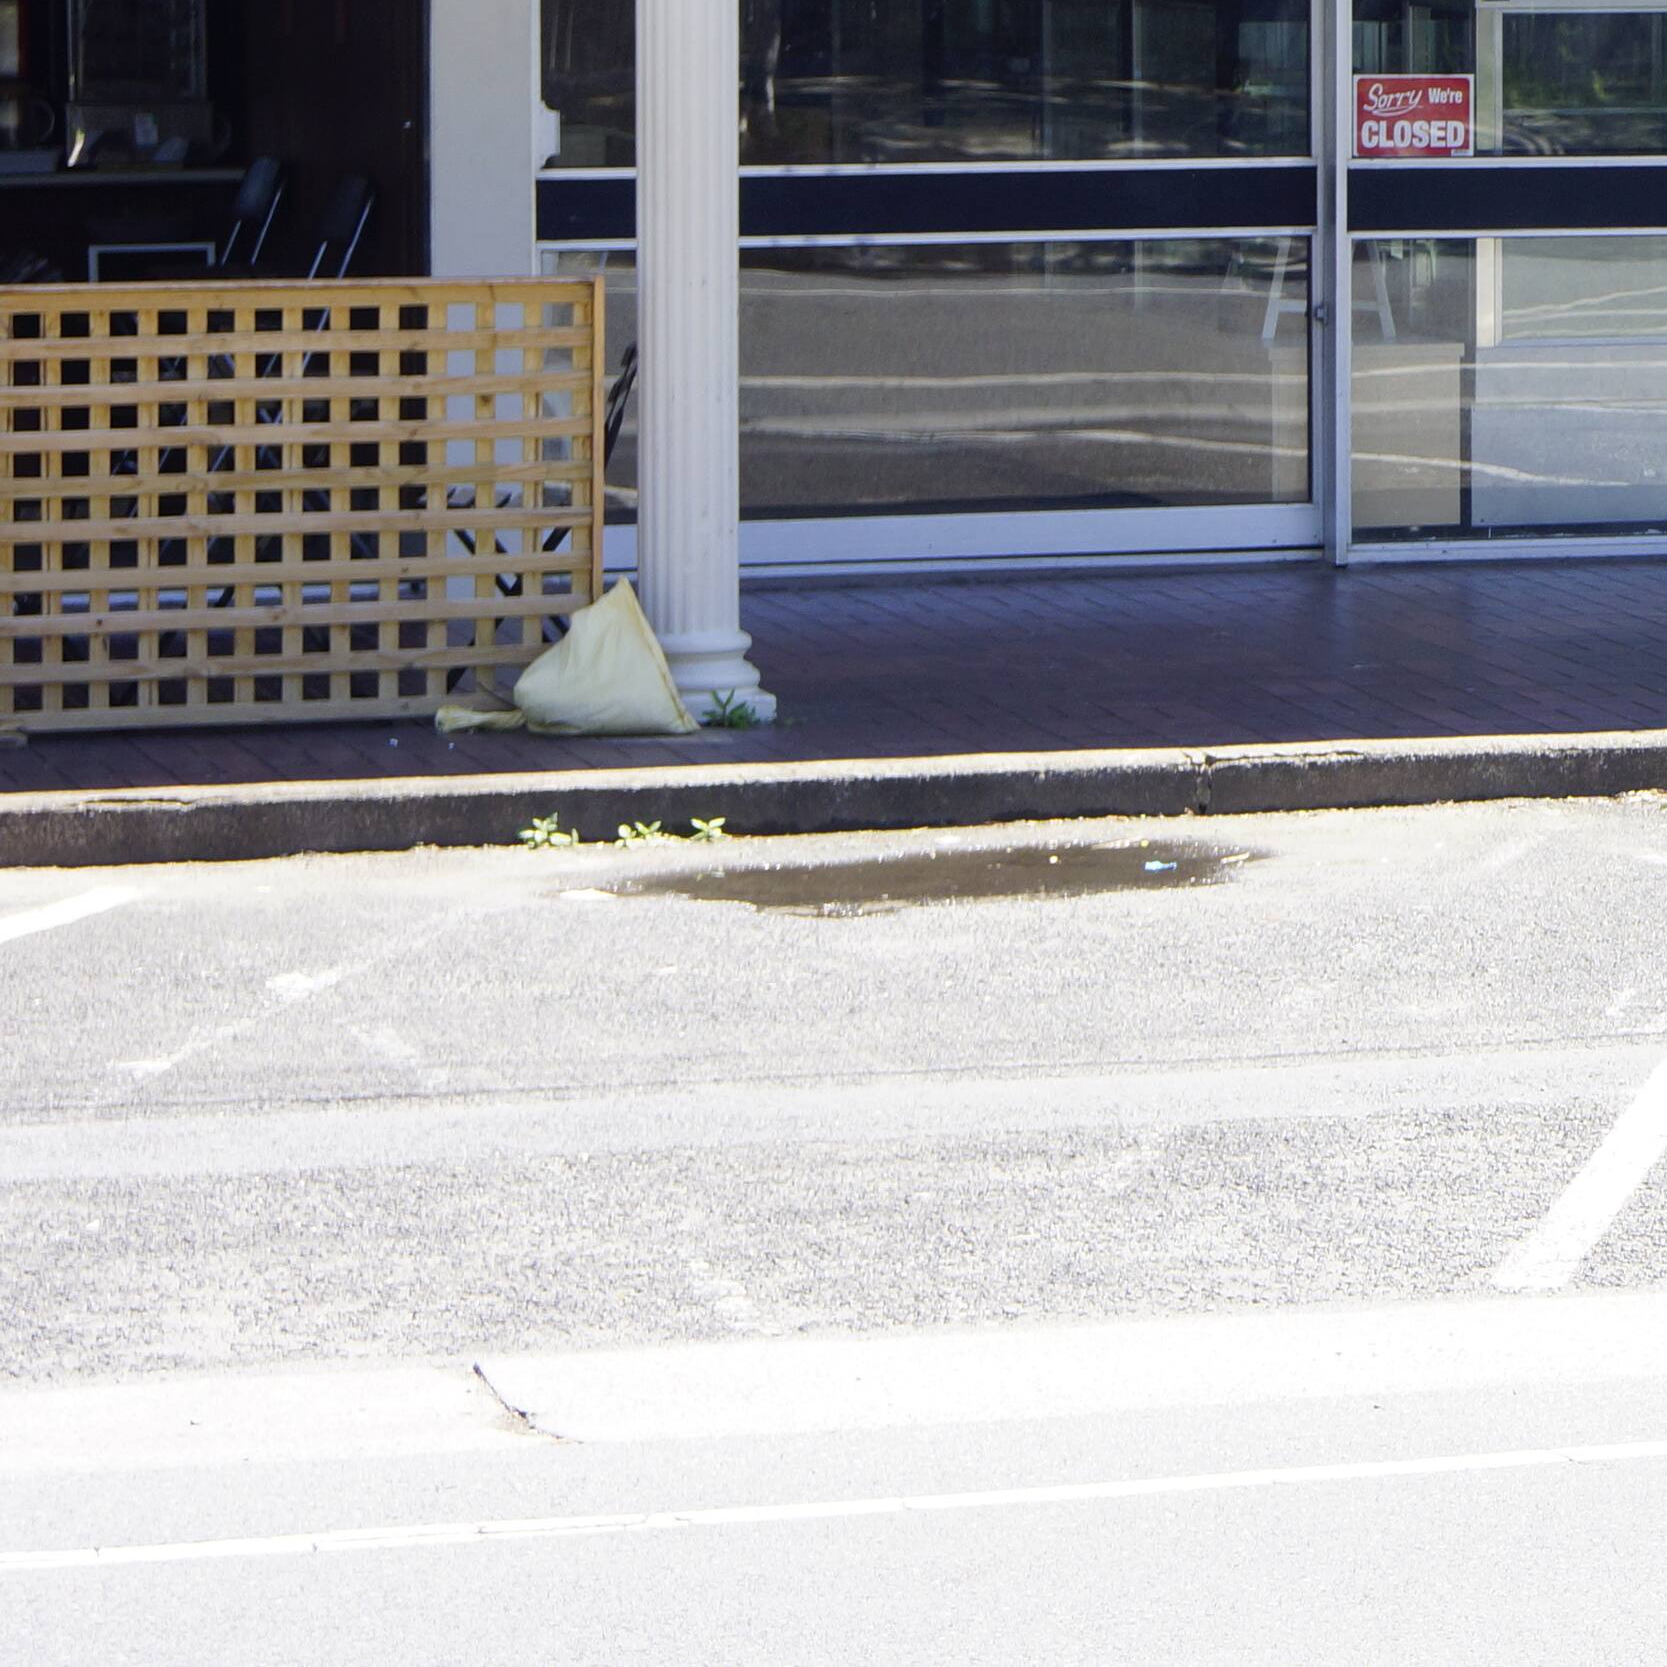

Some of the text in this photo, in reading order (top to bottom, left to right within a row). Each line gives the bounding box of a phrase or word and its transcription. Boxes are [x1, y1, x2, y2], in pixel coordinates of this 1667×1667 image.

[1363, 83, 1463, 114] Sorry We're
[1361, 119, 1465, 149] CLOSED
